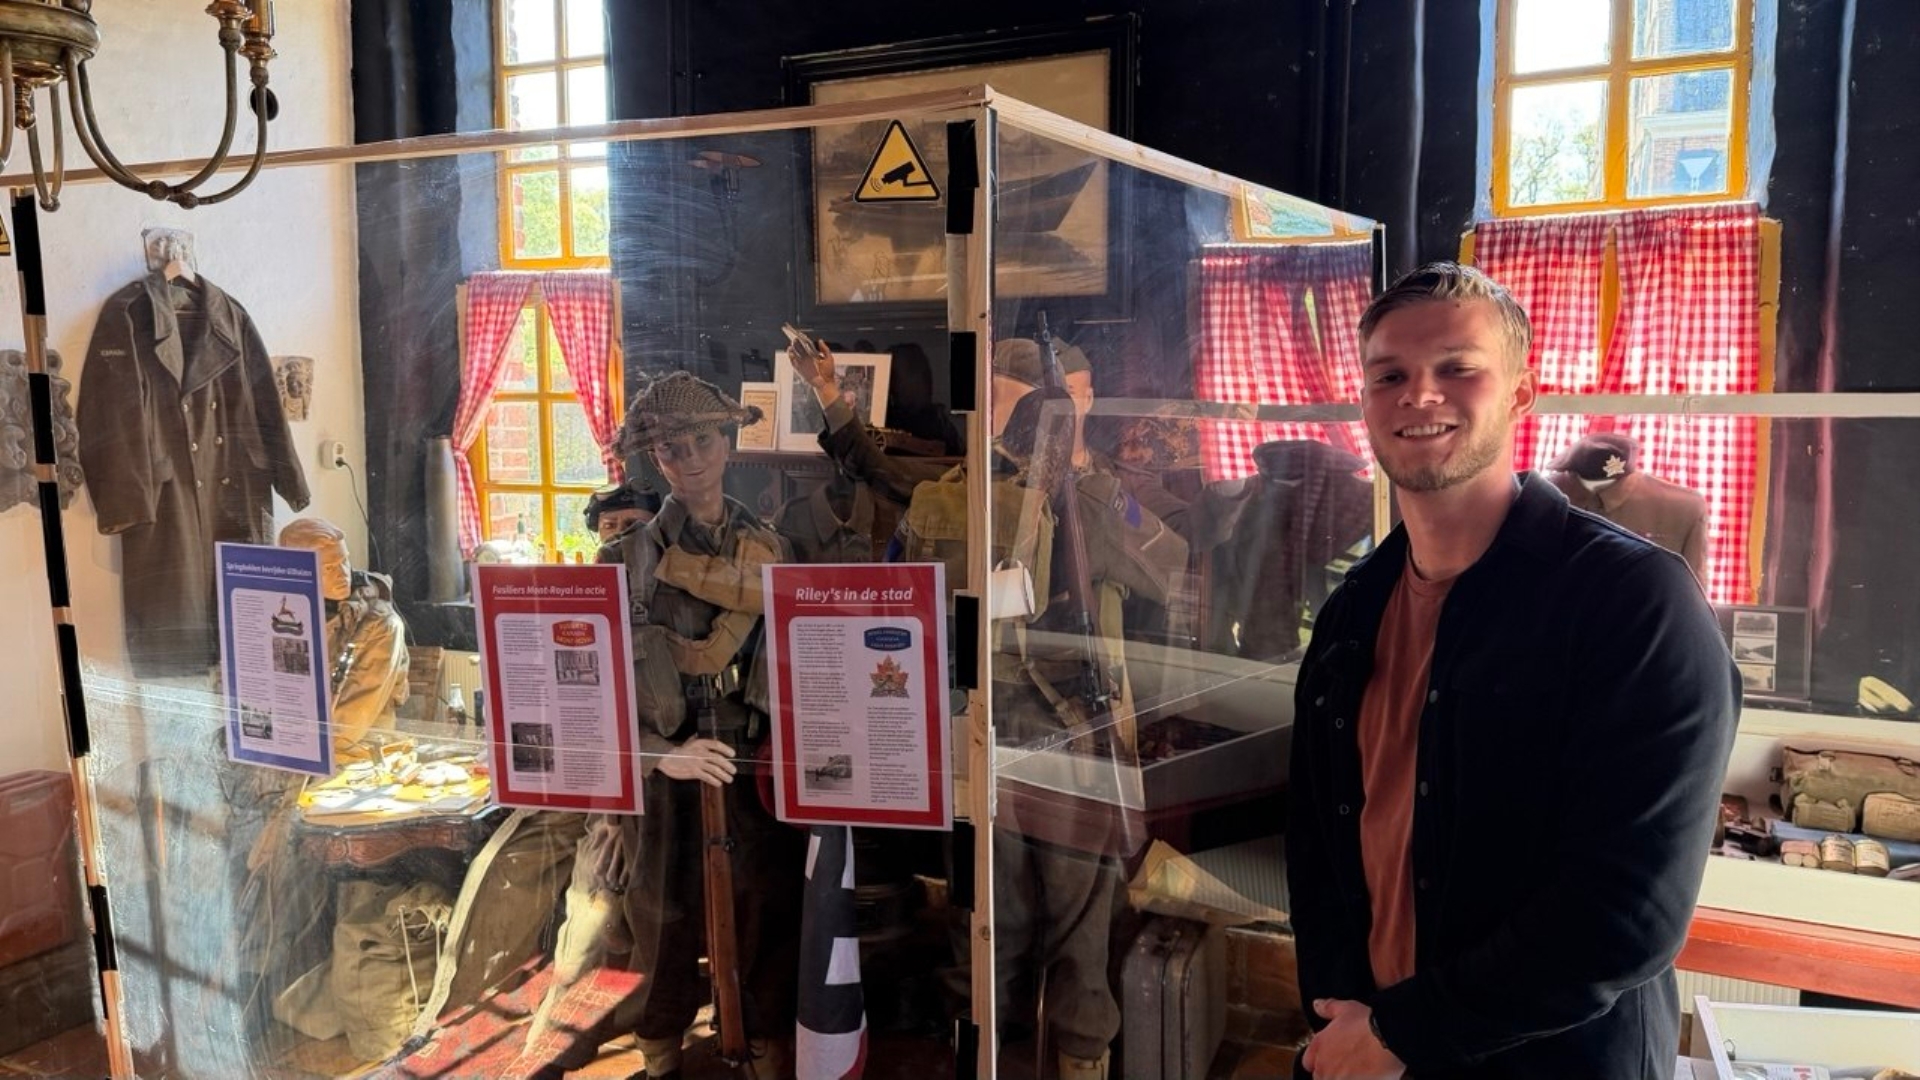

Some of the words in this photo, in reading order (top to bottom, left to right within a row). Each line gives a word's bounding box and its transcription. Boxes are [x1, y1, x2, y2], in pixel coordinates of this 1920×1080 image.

[492, 585, 526, 595] Fusiliers
[526, 585, 574, 597] Mont-Royal
[575, 585, 584, 595] in
[584, 585, 606, 595] actie
[795, 587, 841, 604] Riley's
[843, 587, 858, 601] in
[860, 587, 878, 601] de
[881, 587, 913, 601] stad
